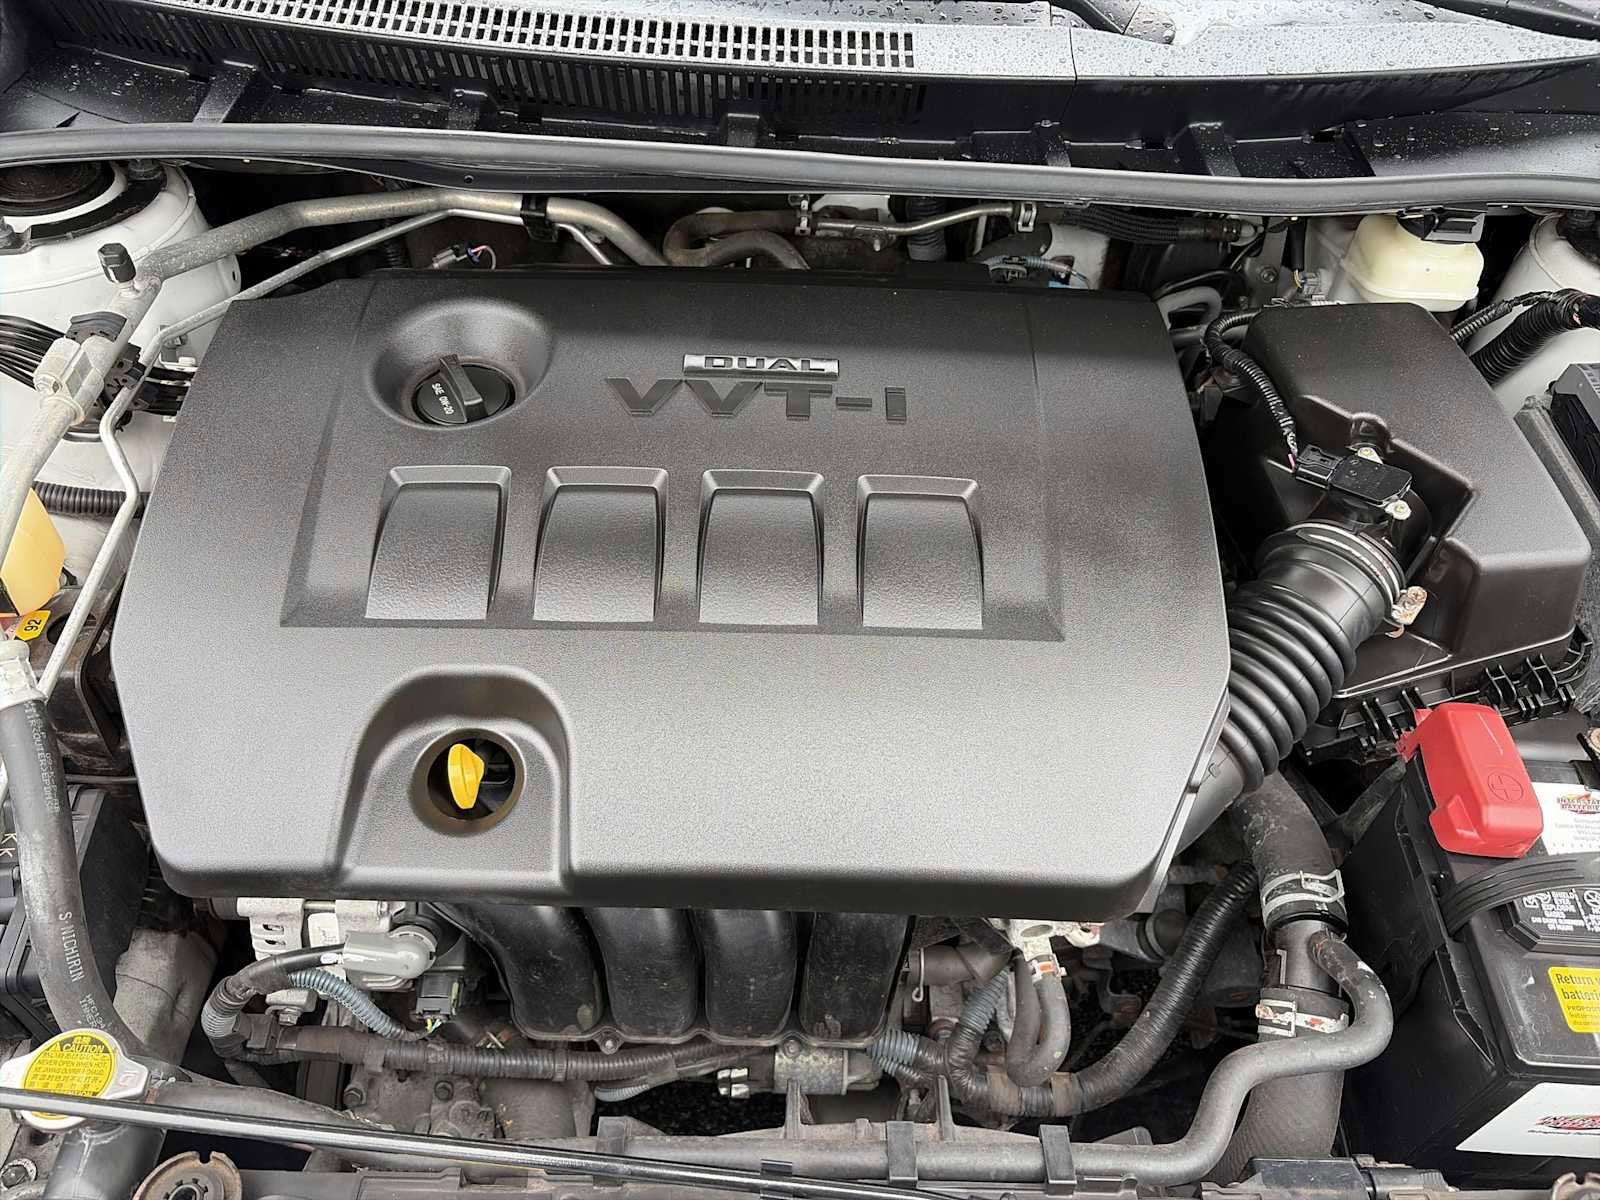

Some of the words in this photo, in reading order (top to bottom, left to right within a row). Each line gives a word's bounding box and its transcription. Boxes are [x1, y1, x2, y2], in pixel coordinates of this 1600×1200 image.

[704, 356, 825, 371] DUAL
[432, 383, 445, 395] SAE
[24, 619, 42, 632] 92
[1555, 973, 1593, 985] Return
[62, 1044, 105, 1053] CAUTION
